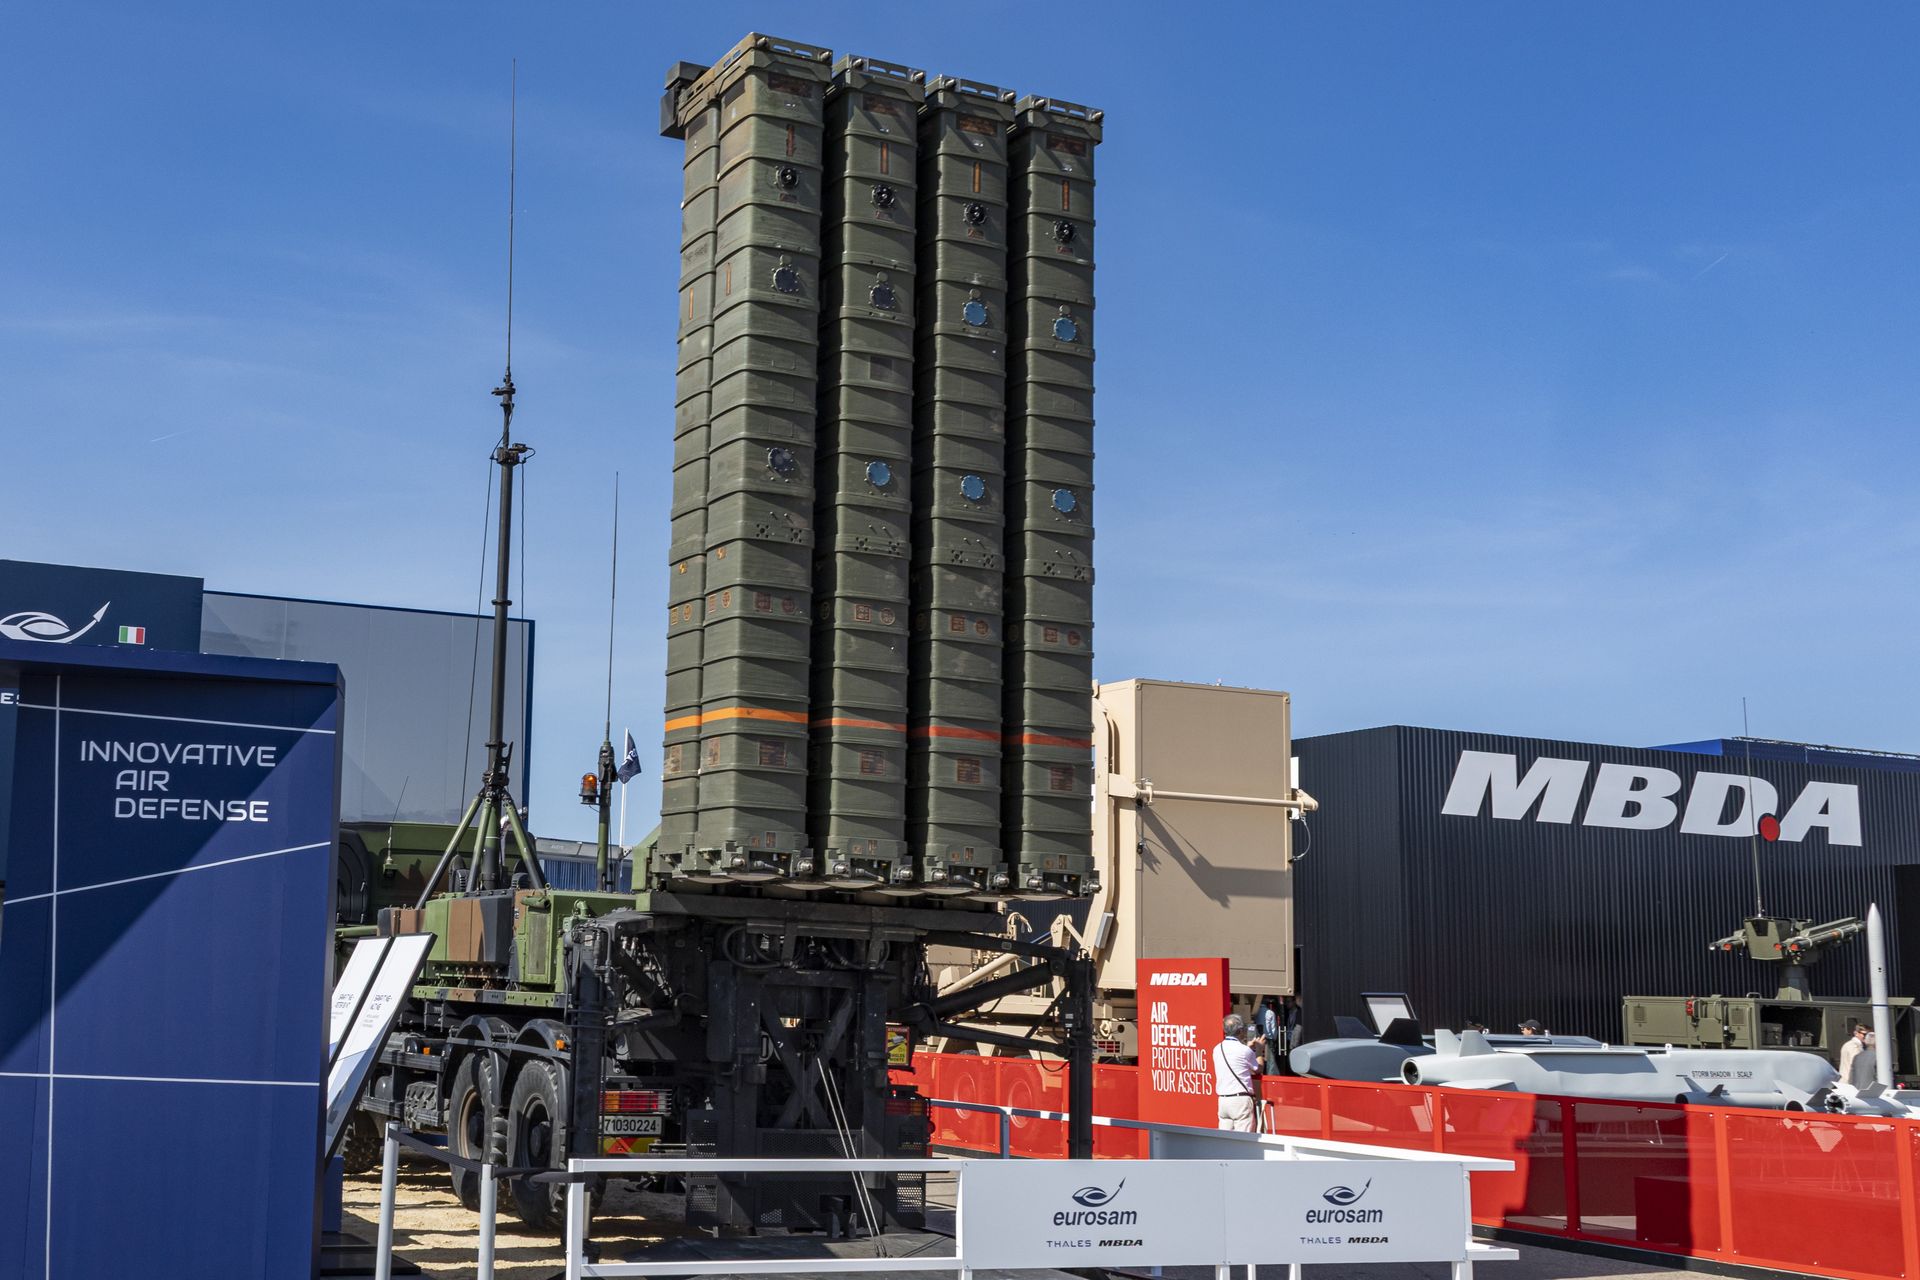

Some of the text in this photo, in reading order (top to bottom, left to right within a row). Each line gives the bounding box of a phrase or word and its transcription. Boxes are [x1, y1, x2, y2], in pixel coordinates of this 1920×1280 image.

[81, 740, 276, 767] INNOVATIVE
[116, 770, 170, 791] AIR
[1441, 750, 1862, 847] MBDA
[115, 797, 269, 822] DEFENSE
[1150, 973, 1208, 986] MBDA
[1151, 1001, 1169, 1023] AIR
[1151, 1024, 1197, 1047] DEFENCE
[1152, 1047, 1207, 1072] PROTECTING
[1151, 1070, 1212, 1096] YOUR ASSETS
[1691, 1070, 1709, 1078] STORM
[1709, 1070, 1731, 1078] SHADOW
[1053, 1210, 1138, 1226] eurosam
[1305, 1209, 1383, 1224] eurosam
[1046, 1239, 1144, 1248] THALES MBDA
[1347, 1236, 1389, 1244] MBDA
